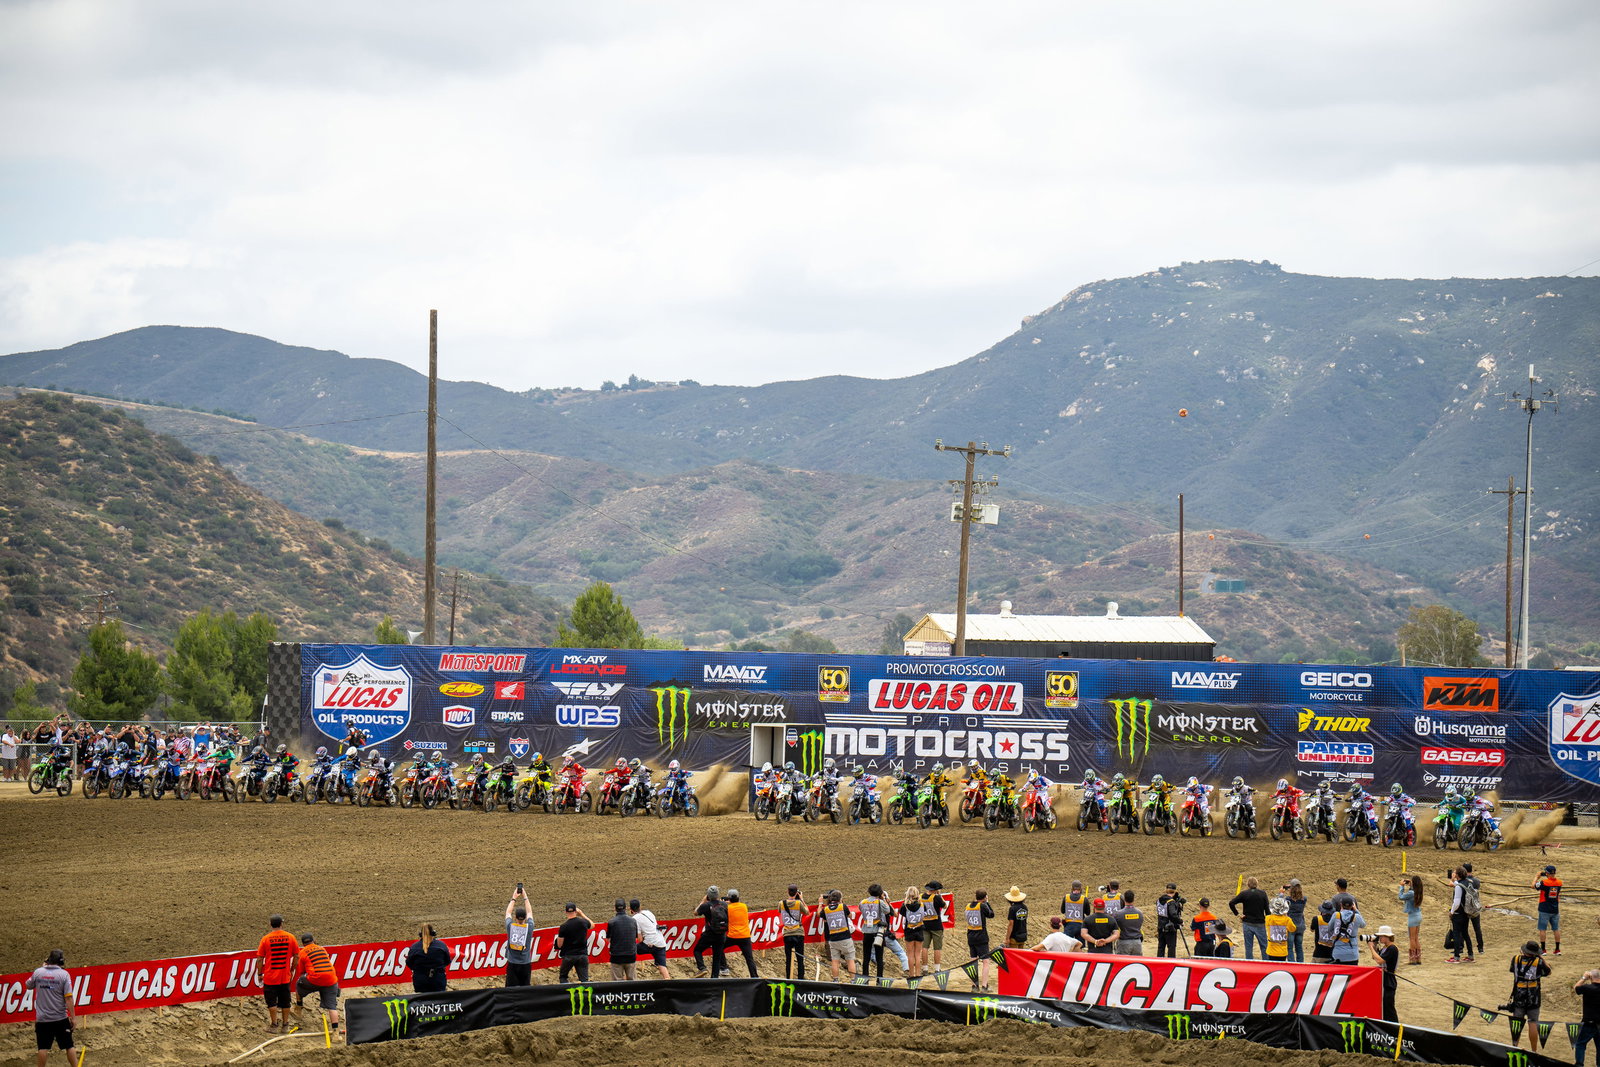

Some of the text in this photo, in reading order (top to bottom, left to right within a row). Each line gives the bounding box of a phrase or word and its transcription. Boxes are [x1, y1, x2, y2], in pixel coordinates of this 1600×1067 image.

[562, 655, 607, 664] MX-ATV
[550, 664, 628, 677] LEGENDS
[886, 663, 1006, 676] PROMOTOCROSS.COM
[823, 669, 847, 689] 50
[1050, 674, 1075, 695] 50
[1213, 680, 1232, 688] PLUS
[1300, 671, 1372, 687] GEICO
[552, 681, 625, 696] FLY
[1426, 682, 1496, 707] KTM
[323, 686, 404, 708] LUCAS
[875, 682, 1017, 712] LUCAS OIL
[1309, 692, 1363, 701] MOTORCYCLE
[318, 713, 404, 725] OIL PRODUCTS
[447, 710, 471, 722] 100%
[490, 711, 525, 721] STACYC
[557, 706, 620, 727] WPS
[912, 716, 978, 727] PRO
[1314, 716, 1371, 732] THOR
[1432, 721, 1506, 738] Husqvarna
[825, 727, 1070, 761] MOTOCROSS
[1173, 734, 1243, 743] ENERGY
[414, 741, 448, 750] SUZUKI
[1298, 741, 1374, 755] PARTS
[1298, 753, 1374, 763] UNLIMITED
[1423, 750, 1502, 763] GASGAS
[1556, 749, 1583, 761] OIL
[1297, 770, 1375, 779] INTENSE
[1438, 774, 1502, 785] DUNLOP
[830, 918, 843, 928] 47
[909, 913, 922, 923] 27
[511, 933, 526, 946] 84
[101, 962, 216, 1004] LUCAS OIL
[1025, 958, 1354, 1017] LUCAS OIL
[604, 1003, 647, 1011] ENERGY
[805, 1004, 849, 1013] ENERGY
[418, 1015, 456, 1023] ENERGY
[1371, 1044, 1408, 1056] ENERY
